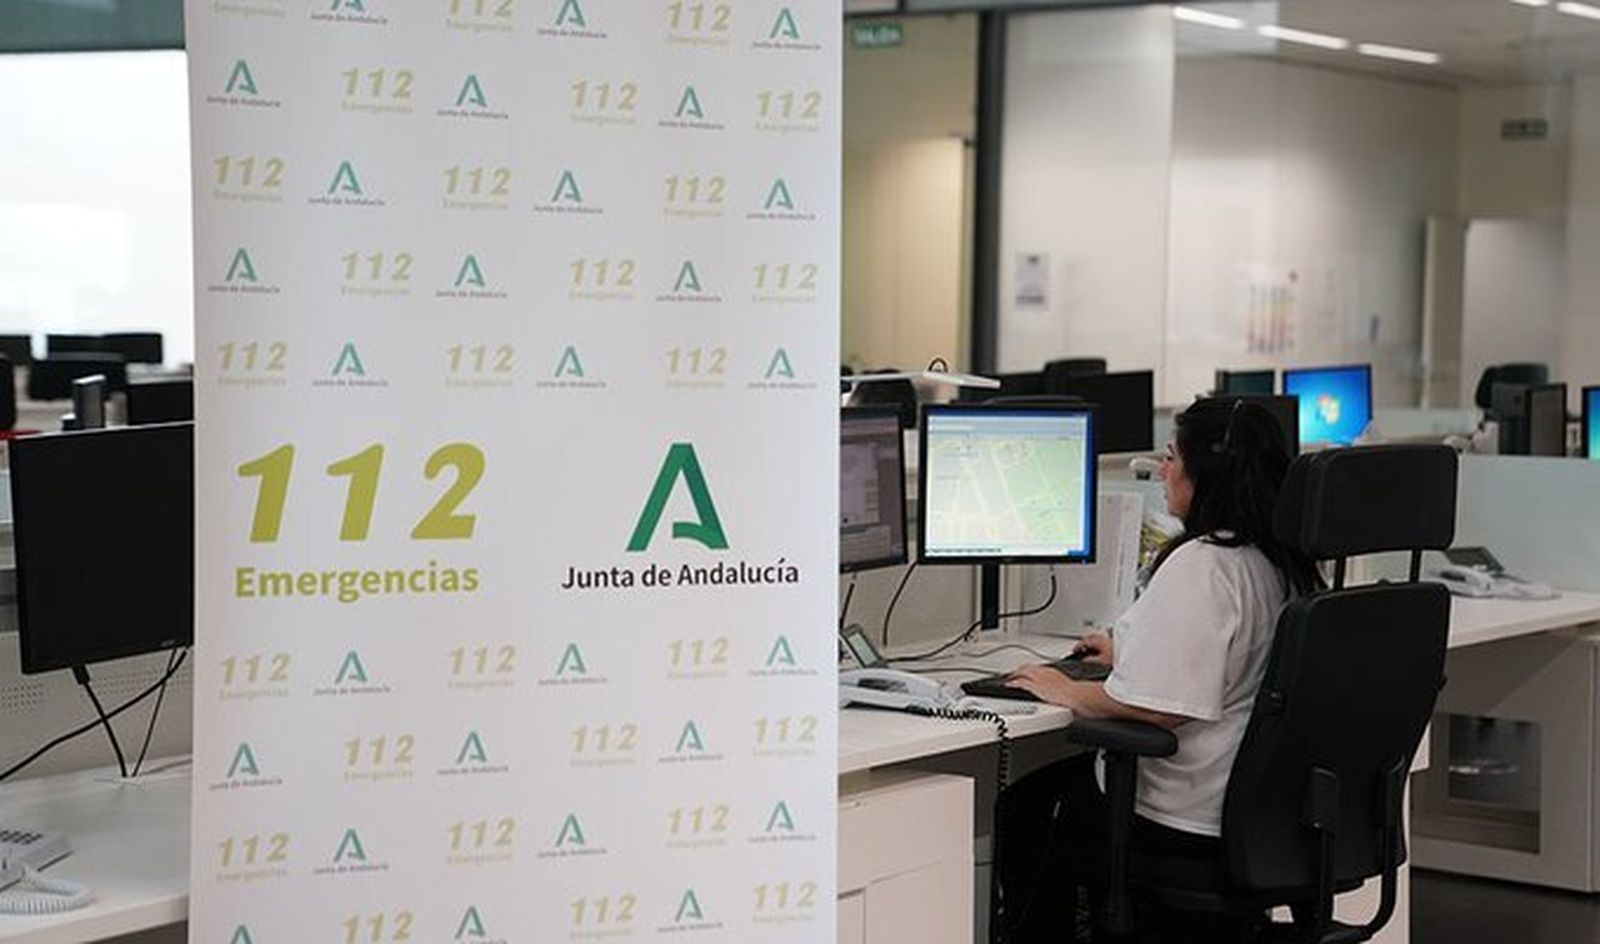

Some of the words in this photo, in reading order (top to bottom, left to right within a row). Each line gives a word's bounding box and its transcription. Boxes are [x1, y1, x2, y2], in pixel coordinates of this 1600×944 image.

[666, 0, 730, 30] 112
[342, 68, 414, 99] 112
[571, 81, 638, 111] 112
[758, 91, 821, 117] 112
[213, 155, 284, 187] 112
[444, 167, 511, 195] 112
[664, 176, 726, 203] 112
[342, 252, 413, 280] 112
[569, 260, 635, 286] 112
[753, 264, 818, 289] 112
[218, 341, 288, 371] 112
[446, 345, 515, 373] 112
[665, 347, 728, 374] 112
[237, 442, 486, 543] 112
[235, 564, 479, 604] Emergencias
[562, 565, 636, 589] Junta
[641, 564, 672, 587] de
[678, 558, 799, 586] Andalucía
[450, 644, 516, 675] 112
[668, 638, 729, 666] 112
[220, 653, 291, 685] 112
[572, 725, 638, 753] 112
[753, 717, 817, 743] 112
[344, 735, 414, 765] 112
[449, 818, 515, 849] 112
[668, 806, 728, 833] 112
[218, 833, 289, 867] 112
[570, 895, 636, 924] 112
[754, 883, 817, 909] 112
[342, 913, 414, 944] 112
